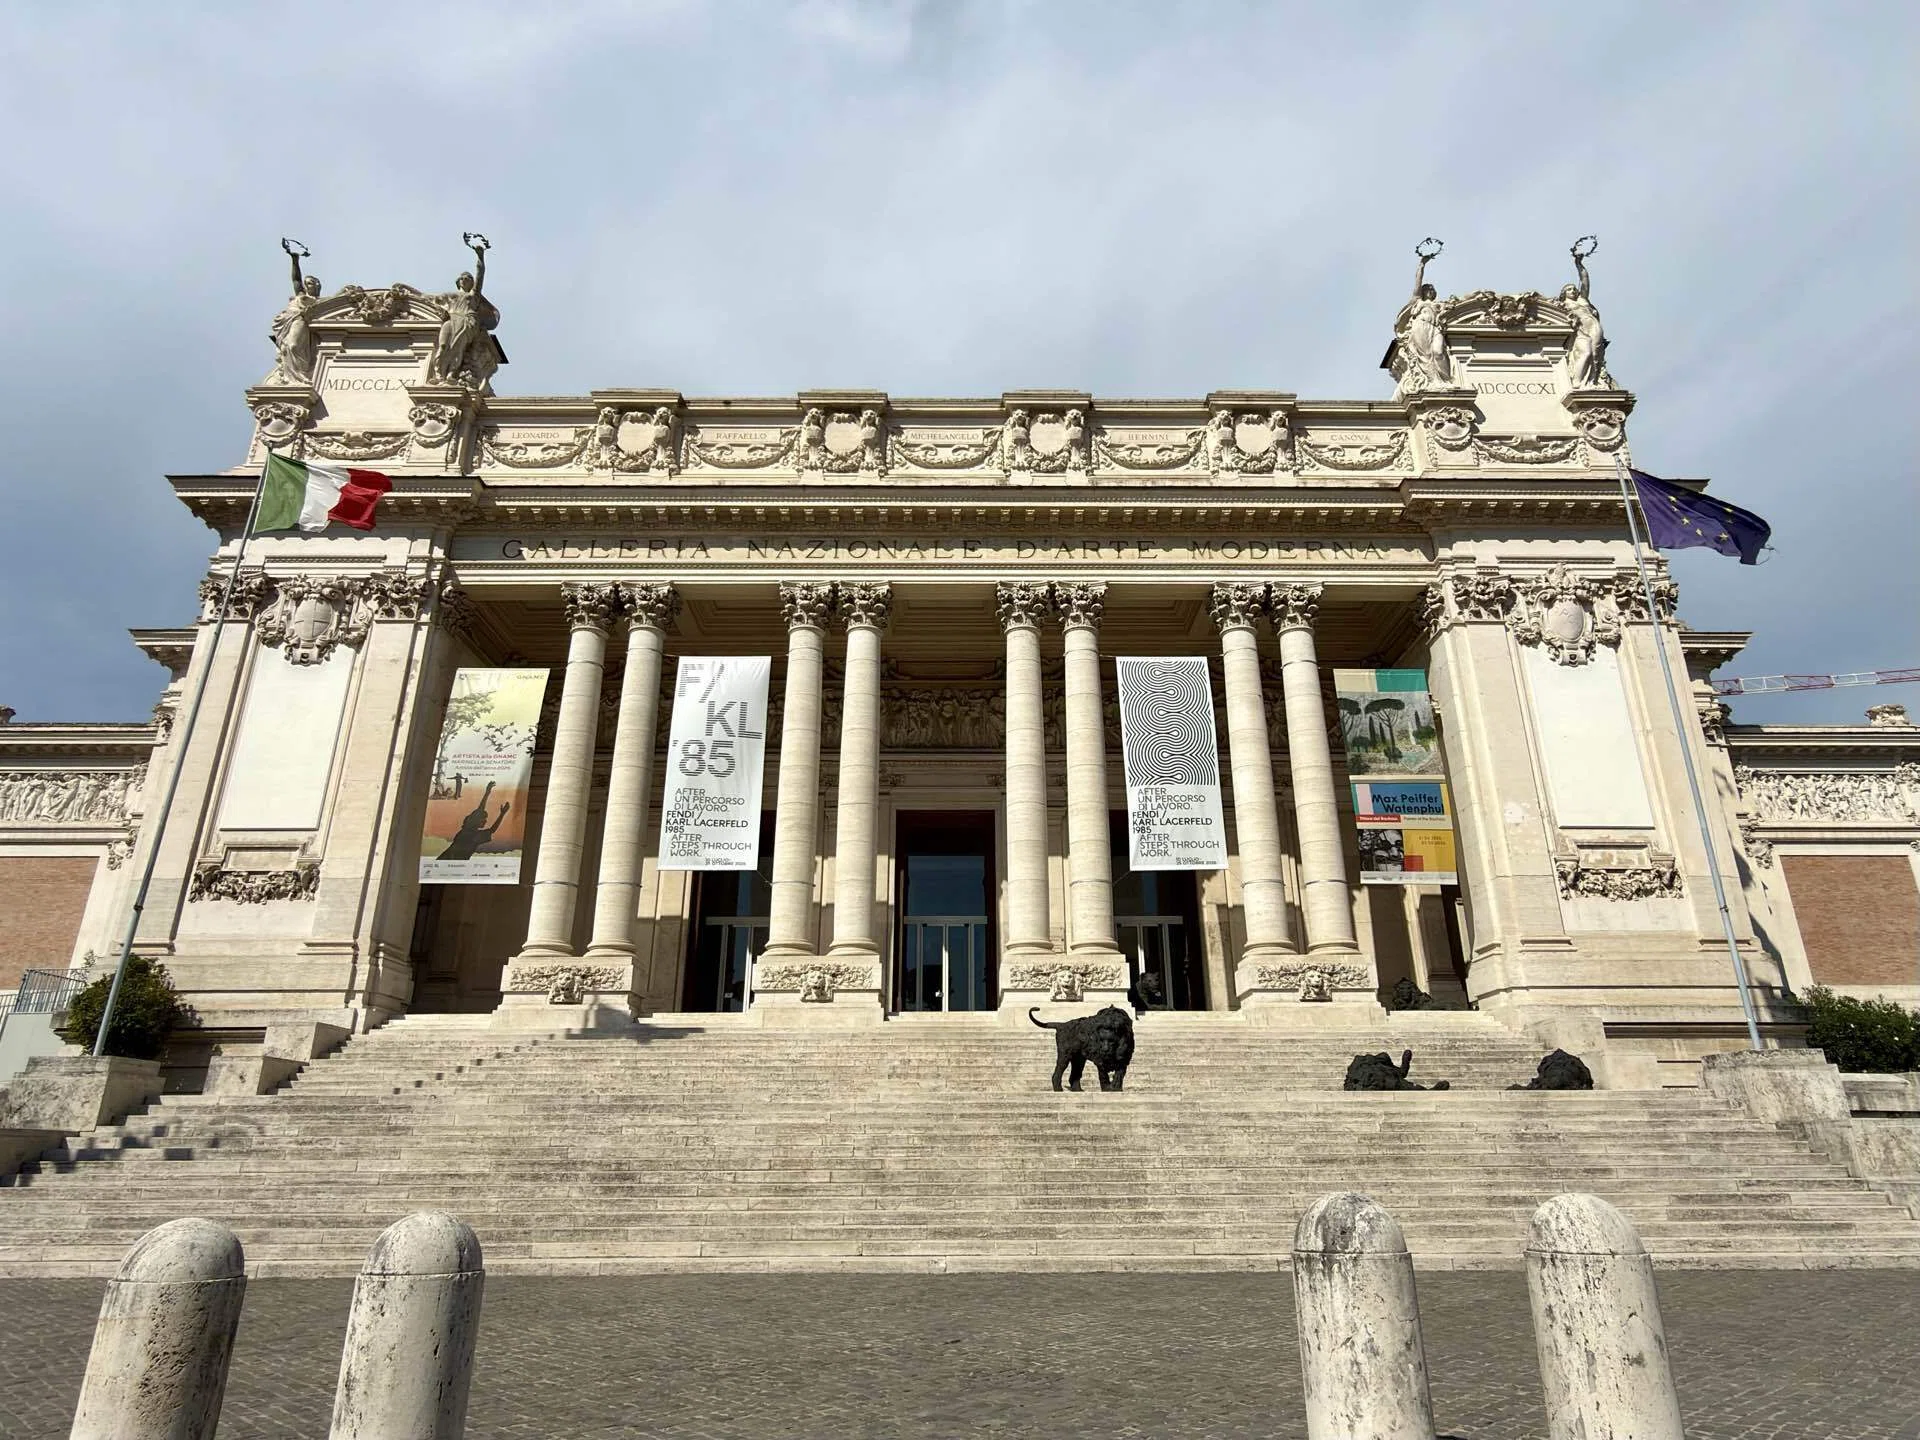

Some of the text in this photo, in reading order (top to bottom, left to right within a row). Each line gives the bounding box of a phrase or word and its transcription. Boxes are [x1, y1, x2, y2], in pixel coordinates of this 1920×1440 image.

[1471, 383, 1556, 395] MDCCCCXI
[511, 431, 560, 440] LEONARDO
[716, 432, 767, 440] RAFFAELLO
[911, 432, 979, 440] MICHELANGELO
[502, 539, 1386, 560] GALLERIA NAZIONALE D'ARTE MODERNA
[705, 701, 763, 739] KL
[671, 739, 736, 778] '85
[675, 788, 706, 796] AFTER
[1138, 787, 1167, 795] AFTER
[692, 796, 745, 805] PERCORSO
[1155, 795, 1206, 803] PERCORSO
[1372, 793, 1438, 803] Max Peiffer
[674, 802, 684, 810] DI
[665, 818, 749, 828] KARL LAGERFELD
[1132, 818, 1157, 826] KARL
[671, 841, 752, 850] STEPS THROUGH
[1171, 841, 1220, 849] THROUGH
[1140, 849, 1172, 857] WORK.
